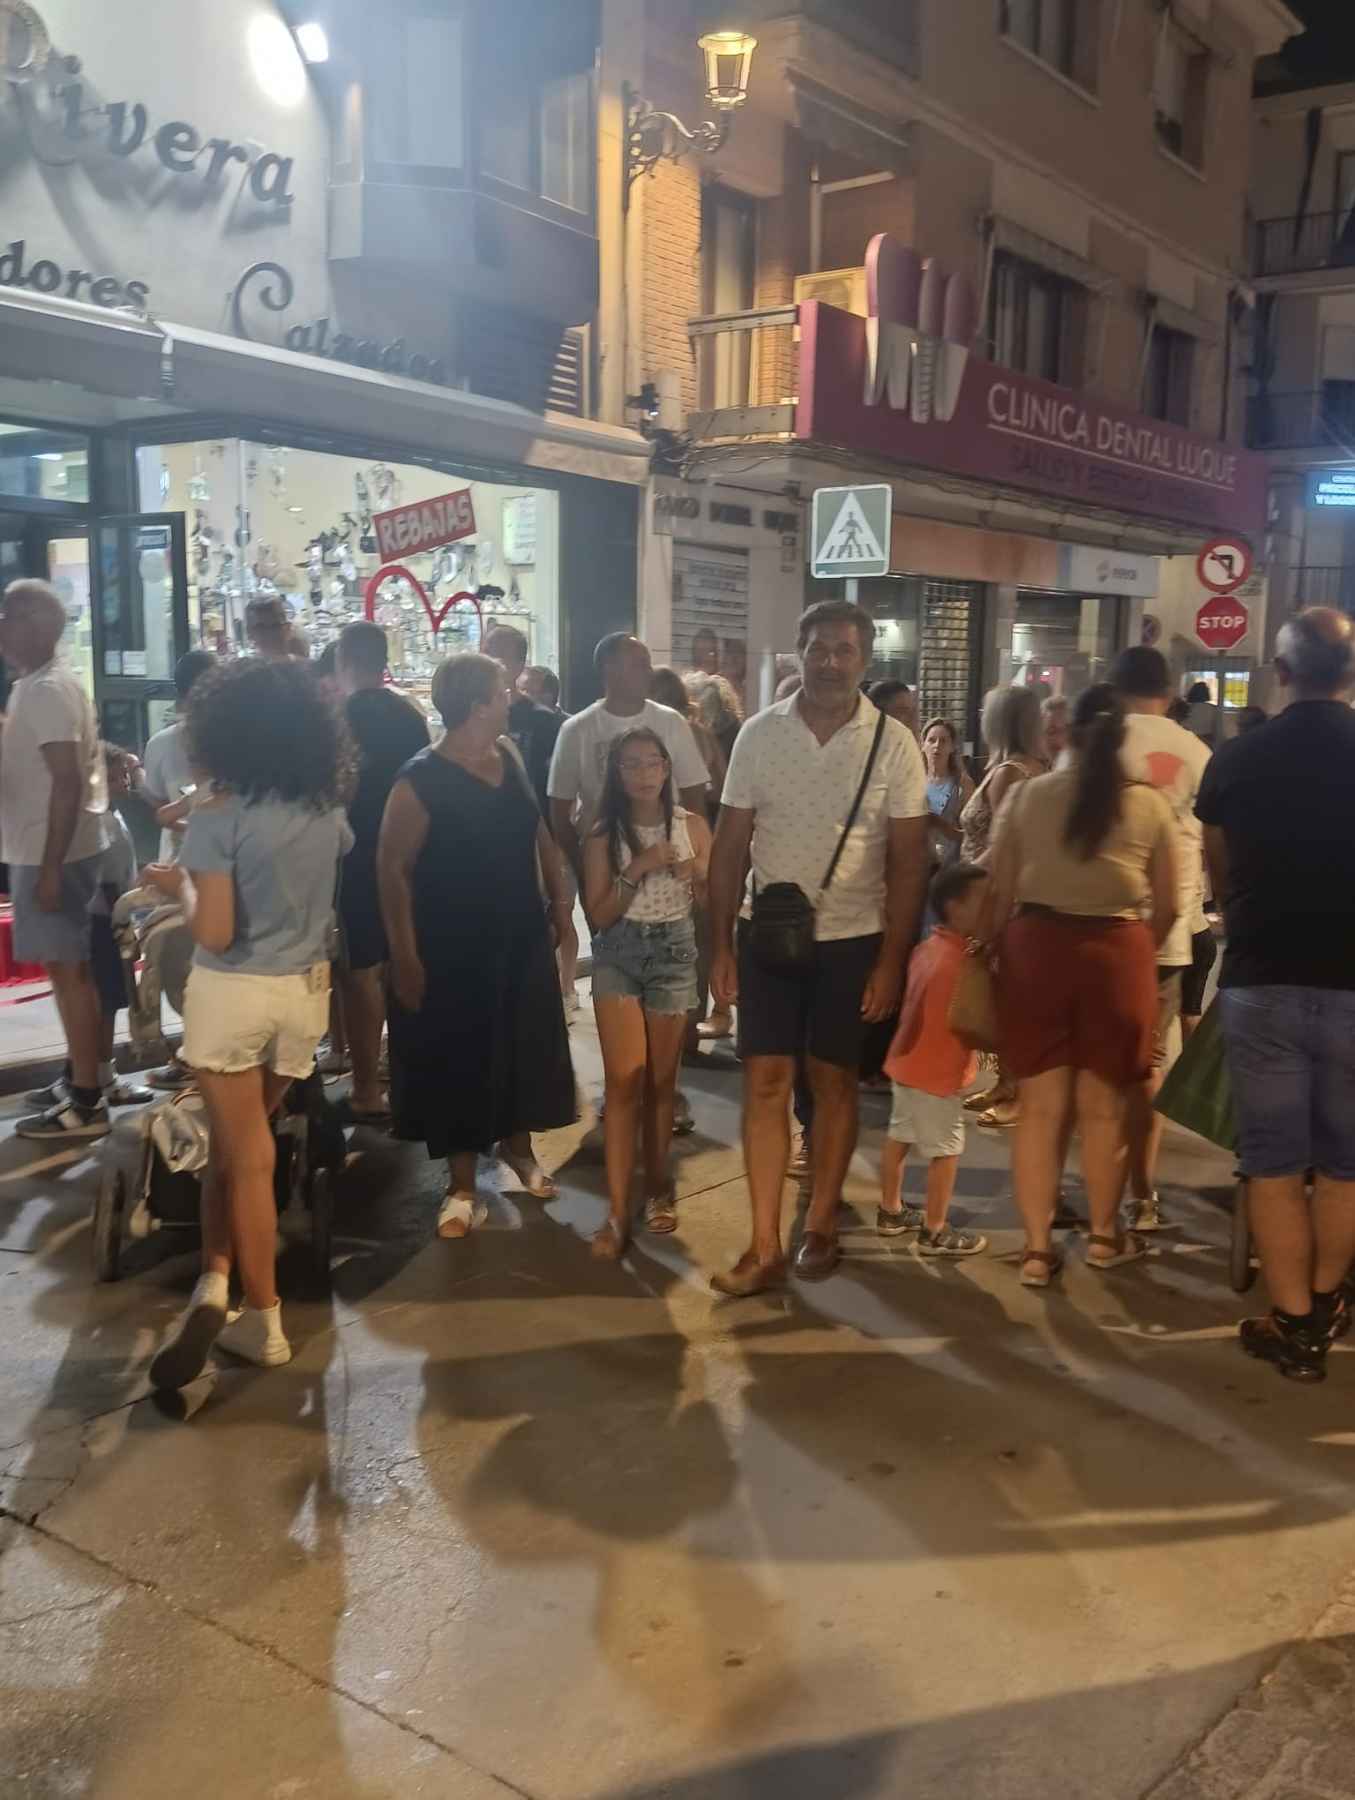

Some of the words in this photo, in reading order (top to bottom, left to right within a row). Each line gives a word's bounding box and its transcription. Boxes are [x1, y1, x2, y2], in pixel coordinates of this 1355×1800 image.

[0, 240, 149, 308] dores
[987, 383, 1090, 445] CLINICA
[1096, 416, 1173, 467] DENTAL
[1177, 443, 1236, 483] LUQUE
[378, 495, 472, 553] REBAJAS
[1200, 616, 1246, 630] STOP
